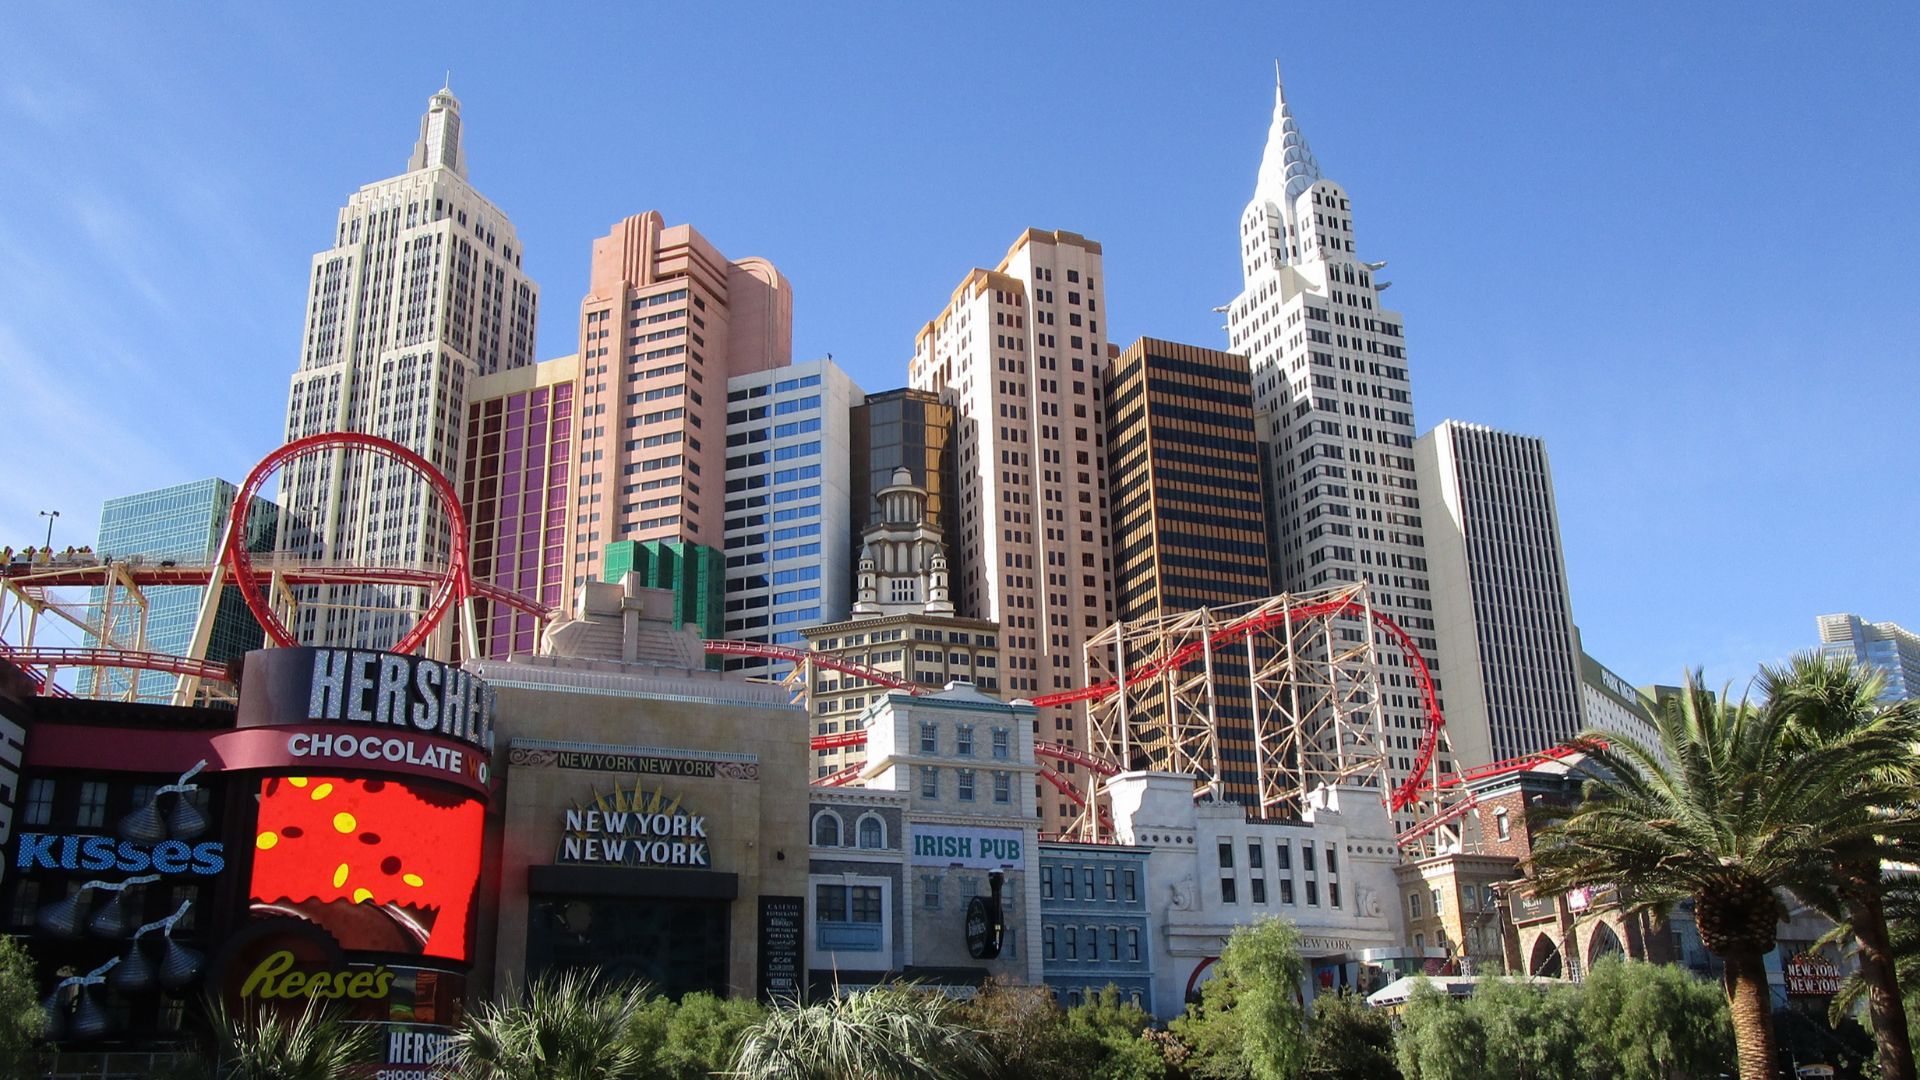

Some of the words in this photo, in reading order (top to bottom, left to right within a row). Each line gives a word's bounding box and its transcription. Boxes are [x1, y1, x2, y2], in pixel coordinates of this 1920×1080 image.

[287, 733, 462, 773] CHOCOLATE
[566, 809, 628, 833] NEW
[635, 813, 706, 838] YORK
[564, 838, 627, 861] NEW
[634, 841, 706, 865] YORK
[915, 835, 972, 858] IRISH
[980, 838, 1020, 860] PUB
[1324, 939, 1352, 951] YORK
[240, 950, 395, 999] Reese's
